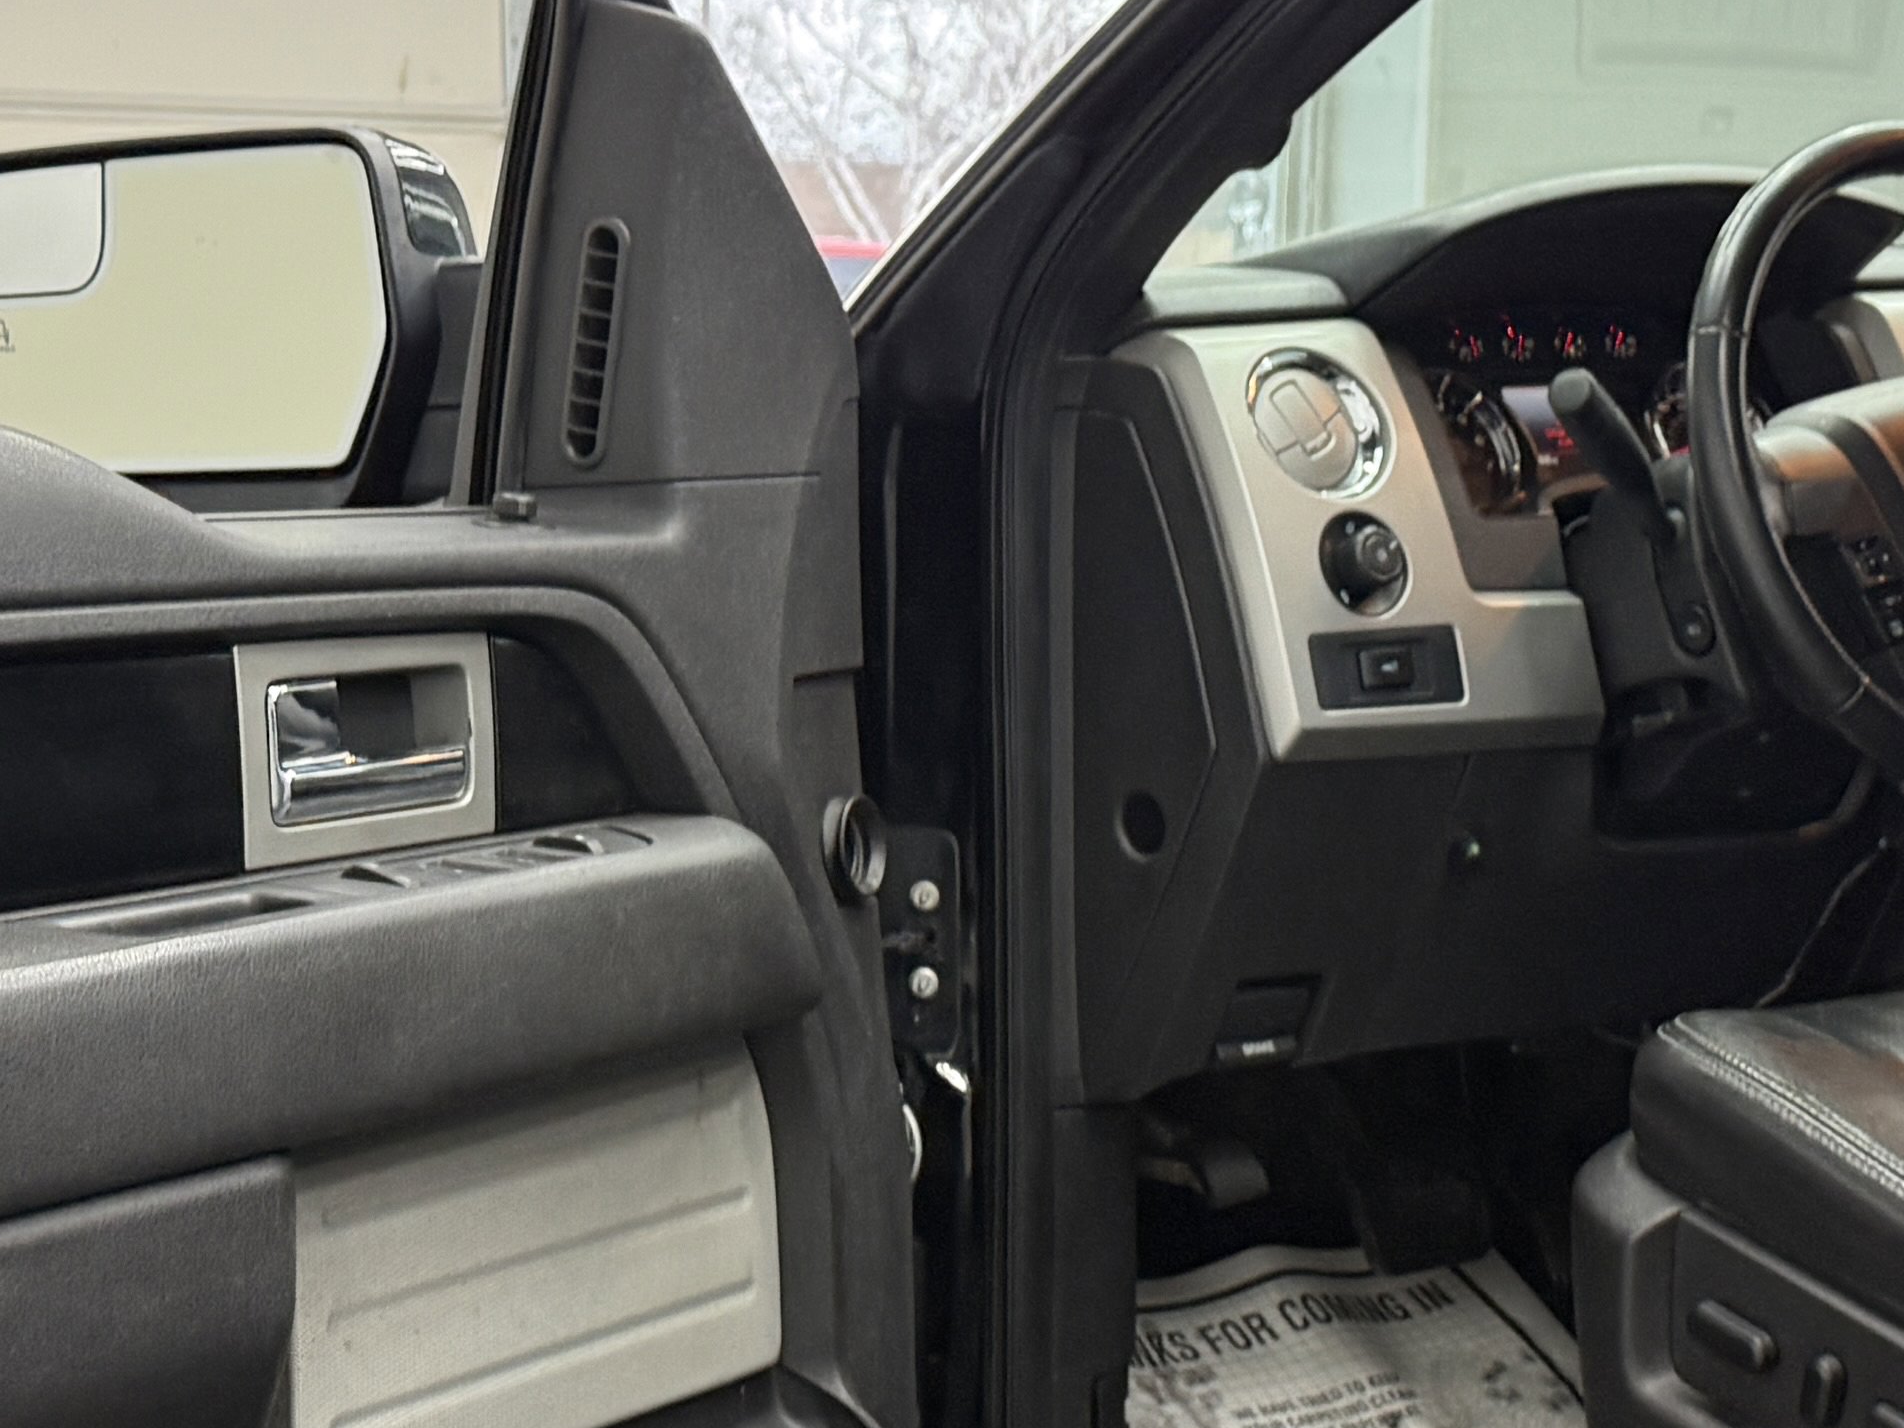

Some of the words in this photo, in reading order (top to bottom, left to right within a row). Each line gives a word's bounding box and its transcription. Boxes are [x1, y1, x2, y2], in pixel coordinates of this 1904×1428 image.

[1200, 1309, 1280, 1357] FOR
[1277, 1290, 1412, 1333] COMING
[1406, 1278, 1456, 1314] IN
